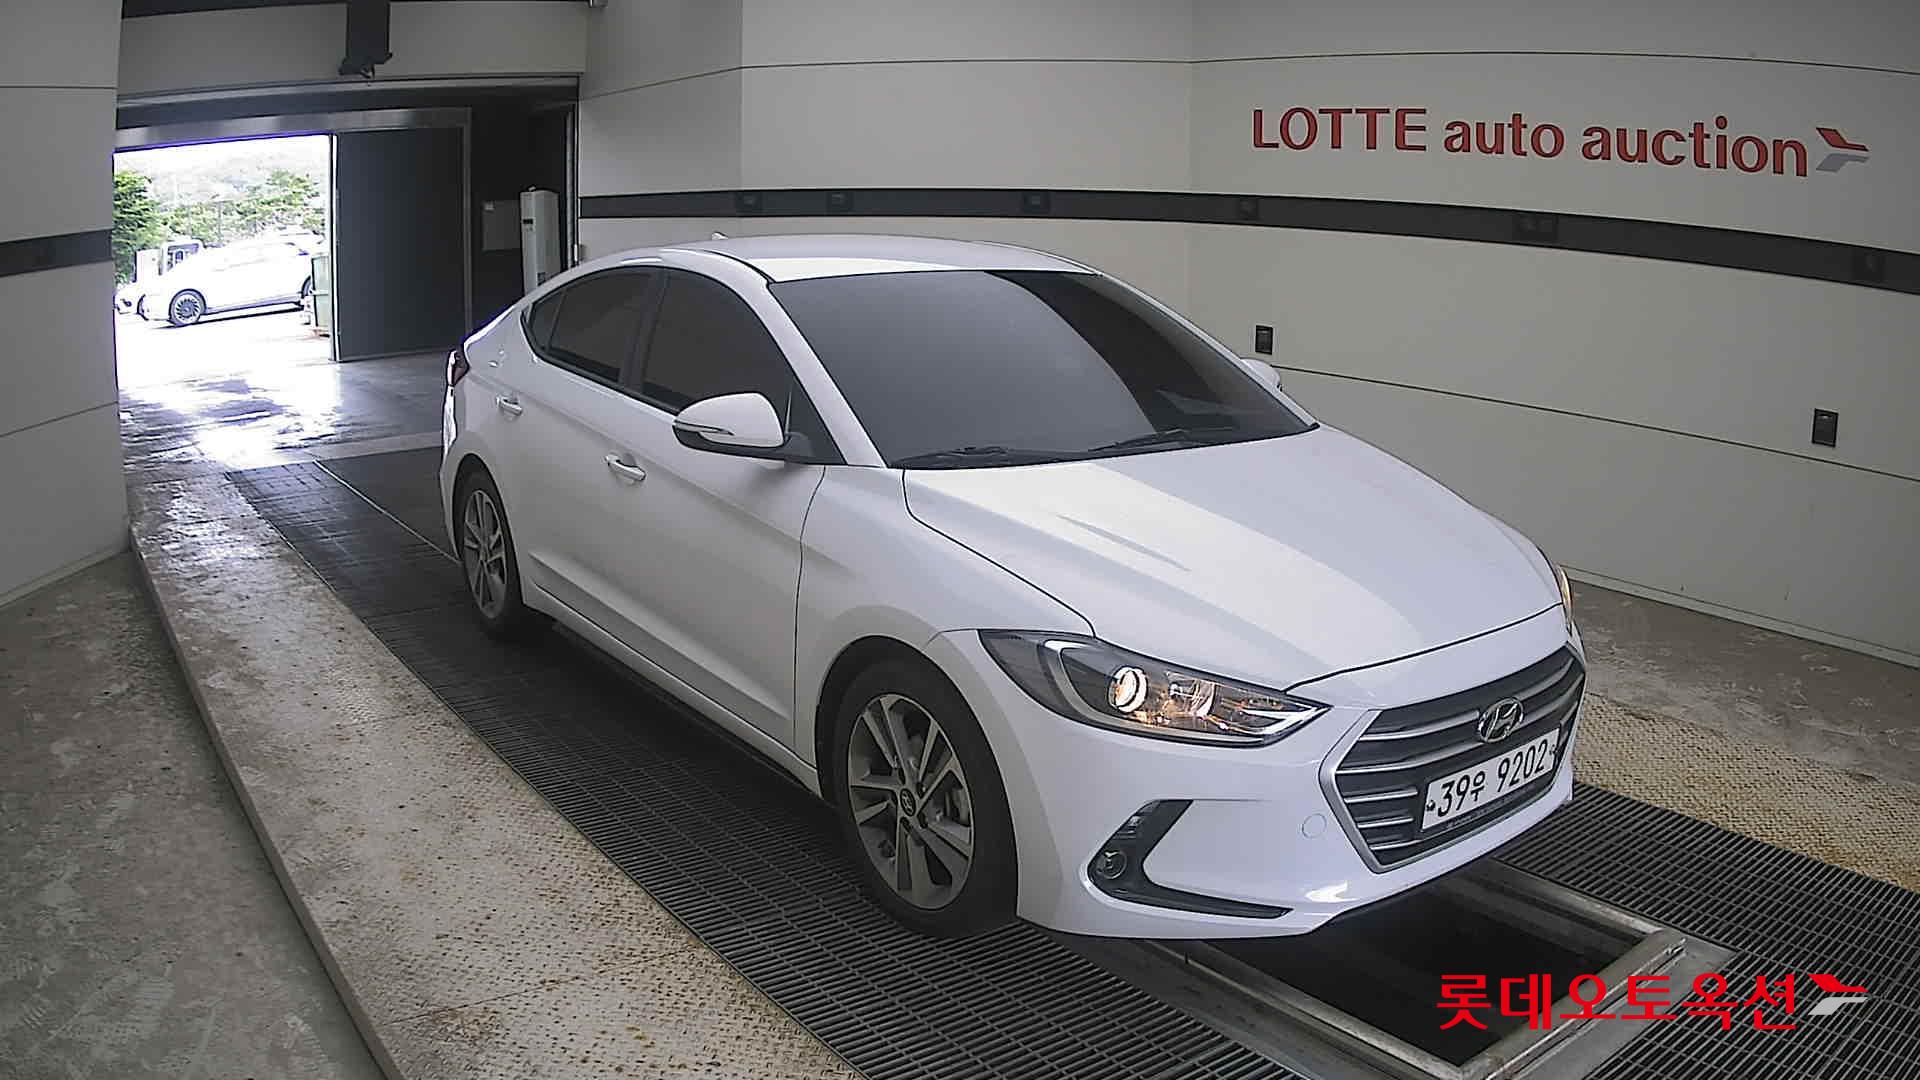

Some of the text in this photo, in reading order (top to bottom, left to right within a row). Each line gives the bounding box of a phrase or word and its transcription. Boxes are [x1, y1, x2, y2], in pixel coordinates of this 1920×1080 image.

[1252, 107, 1808, 176] LOTTE auto auction
[1437, 771, 1486, 818] 39우
[1497, 738, 1549, 793] 9202
